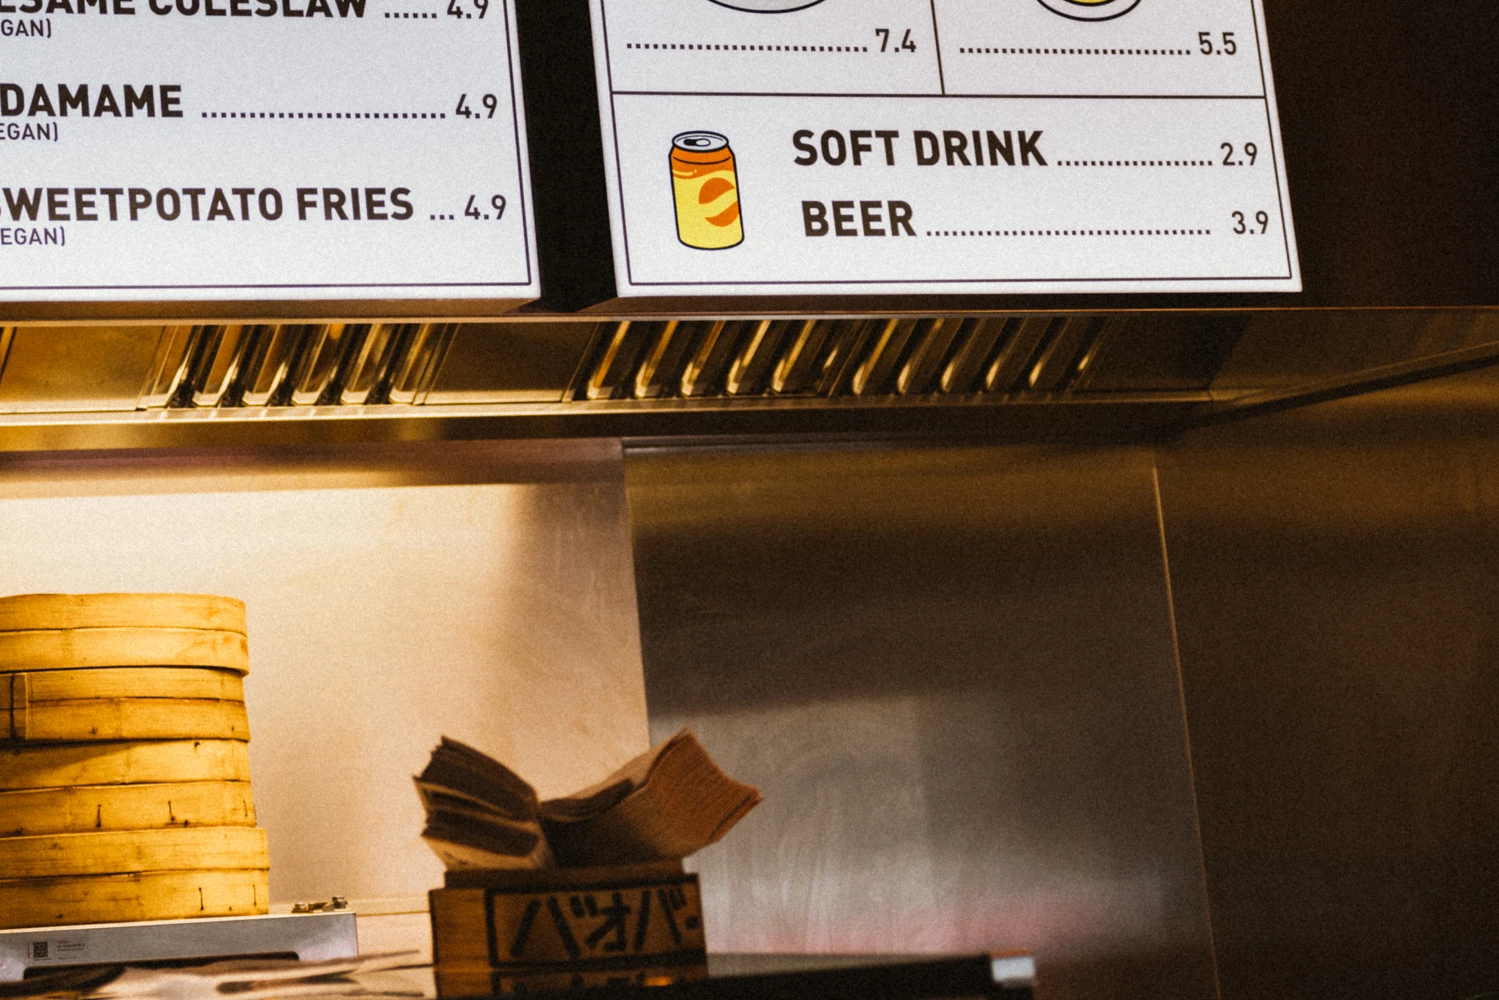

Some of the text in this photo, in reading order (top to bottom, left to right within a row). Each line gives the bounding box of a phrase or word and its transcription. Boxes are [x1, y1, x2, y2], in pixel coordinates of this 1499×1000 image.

[874, 27, 917, 54] 7.4
[1197, 30, 1238, 57] 5.5
[454, 92, 498, 120] 4.9
[791, 128, 1259, 167] SOFT DRINK 2.9
[295, 186, 415, 221] FRIES
[463, 193, 507, 221] 4.9
[800, 199, 1270, 238] BEER 3.9
